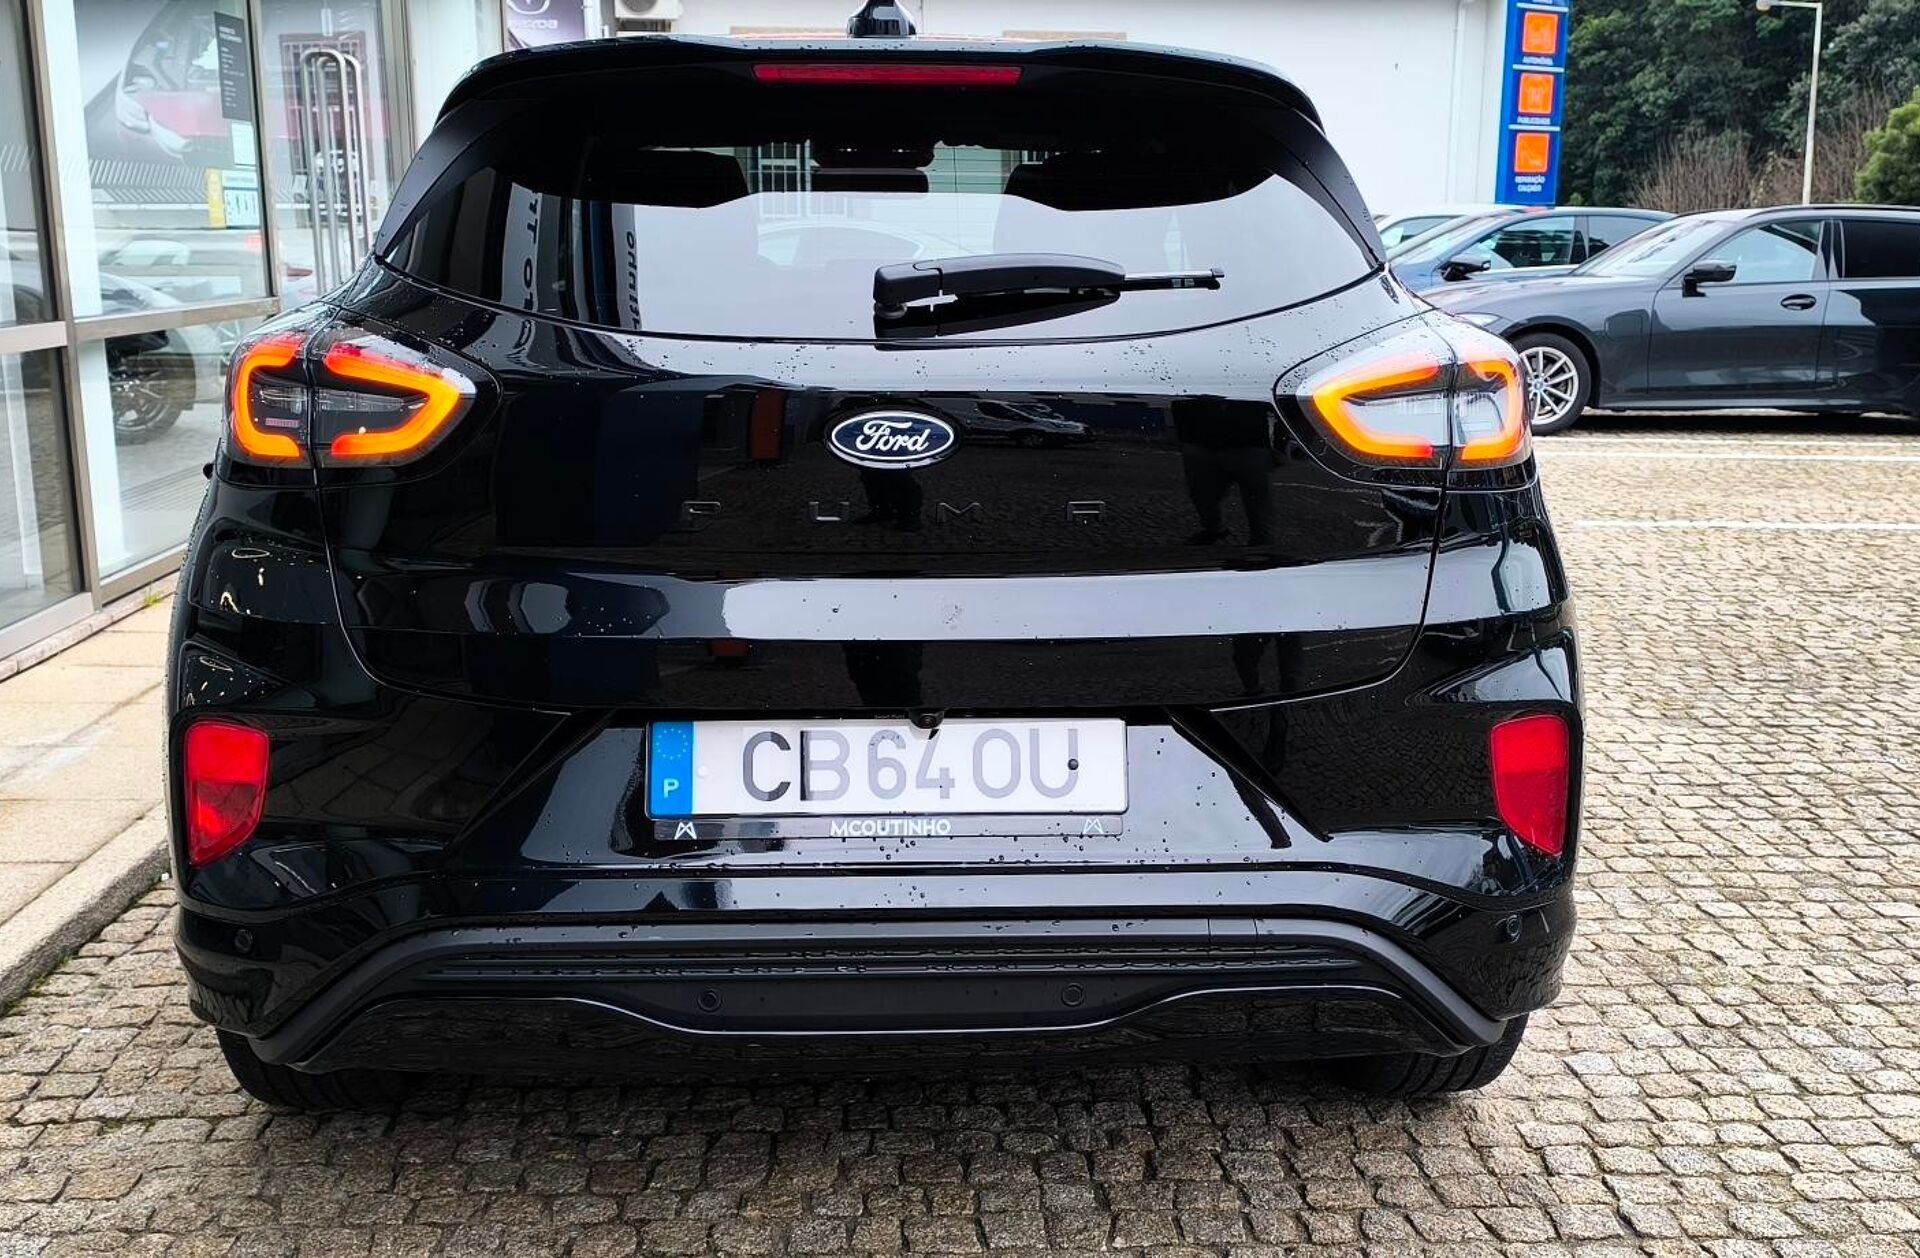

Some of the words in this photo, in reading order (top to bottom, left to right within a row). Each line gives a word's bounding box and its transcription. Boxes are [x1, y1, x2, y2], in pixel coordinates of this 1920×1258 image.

[855, 420, 932, 451] Ford
[662, 778, 680, 799] P
[830, 819, 952, 837] MCOUTINHO
